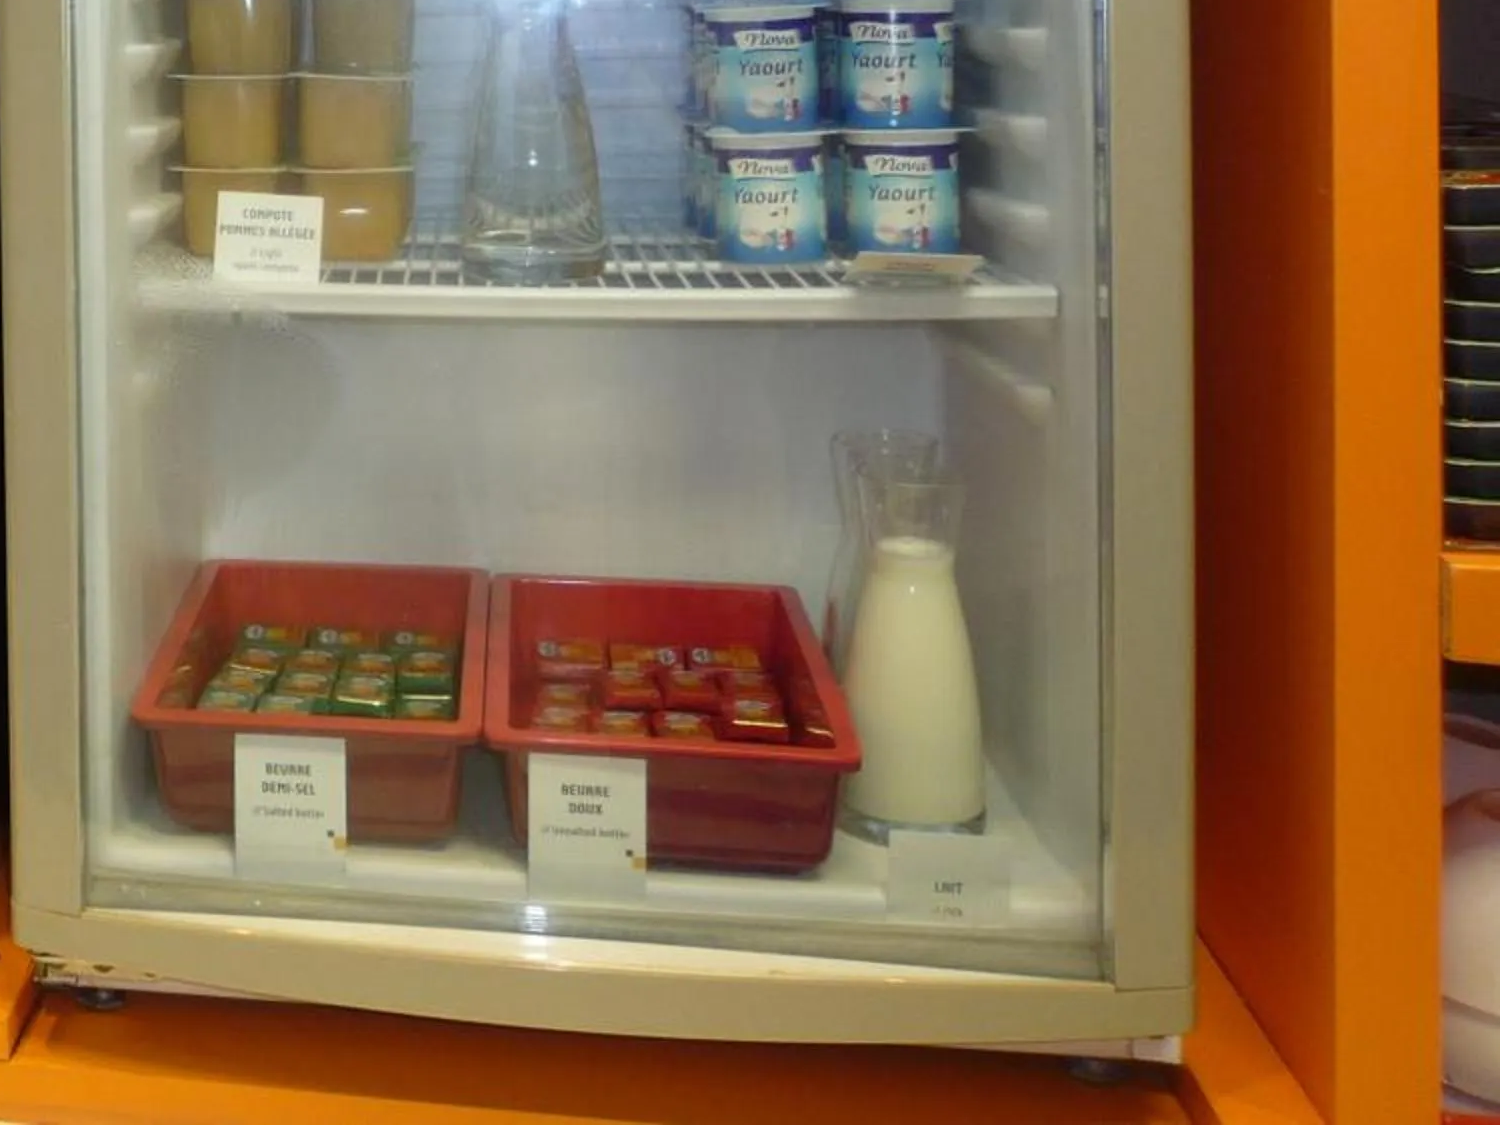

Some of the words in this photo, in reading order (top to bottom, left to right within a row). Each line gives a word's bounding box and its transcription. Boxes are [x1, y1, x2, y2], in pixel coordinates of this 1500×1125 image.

[746, 31, 796, 46] Nova
[739, 58, 803, 76] Yaourt
[852, 53, 916, 70] Yaourt
[738, 160, 790, 175] Nova
[875, 157, 927, 172] Nova
[734, 187, 798, 205] Yaourt
[868, 185, 934, 203] Yaourt
[561, 783, 610, 798] BEURRE
